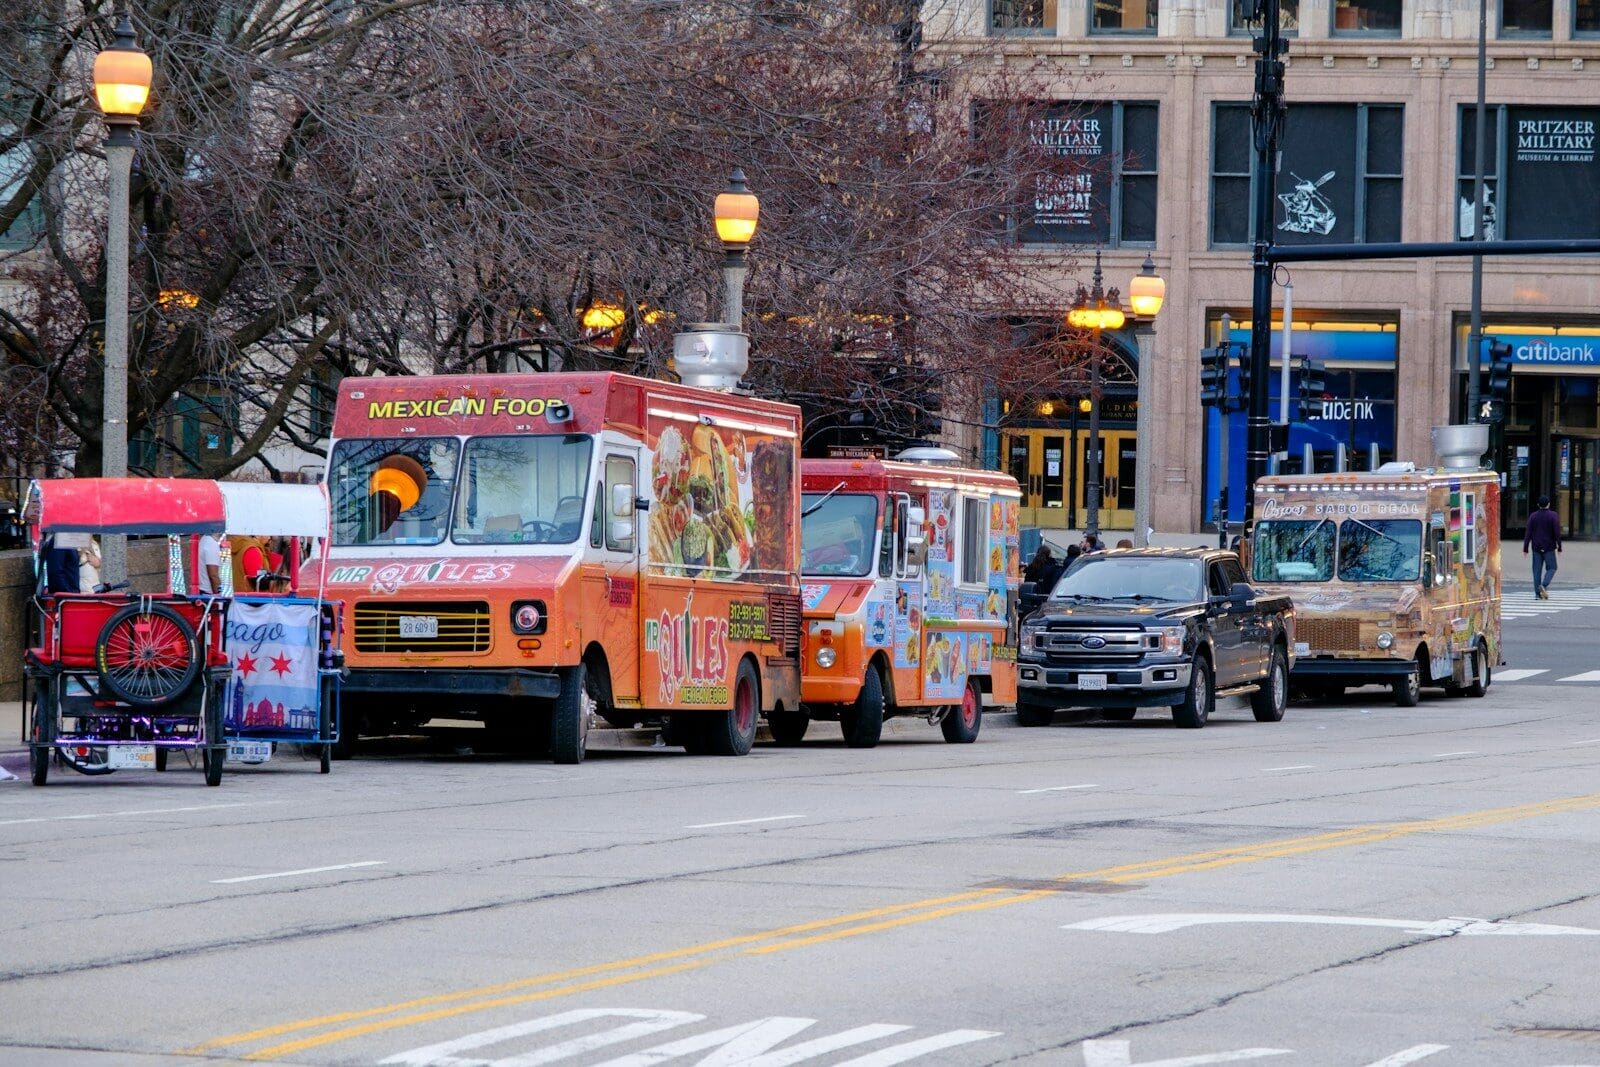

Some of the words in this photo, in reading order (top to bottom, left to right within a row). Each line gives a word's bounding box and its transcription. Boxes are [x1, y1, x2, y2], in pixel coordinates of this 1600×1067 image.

[1518, 120, 1595, 134] PRITZKER
[1518, 135, 1595, 149] MILITARY
[1516, 340, 1594, 362] citibank
[368, 397, 485, 419] MEXICAN
[1309, 395, 1374, 420] tibank
[1316, 503, 1371, 515] SABOR
[1378, 503, 1420, 515] REAL
[328, 565, 373, 583] MR
[226, 619, 286, 654] cago
